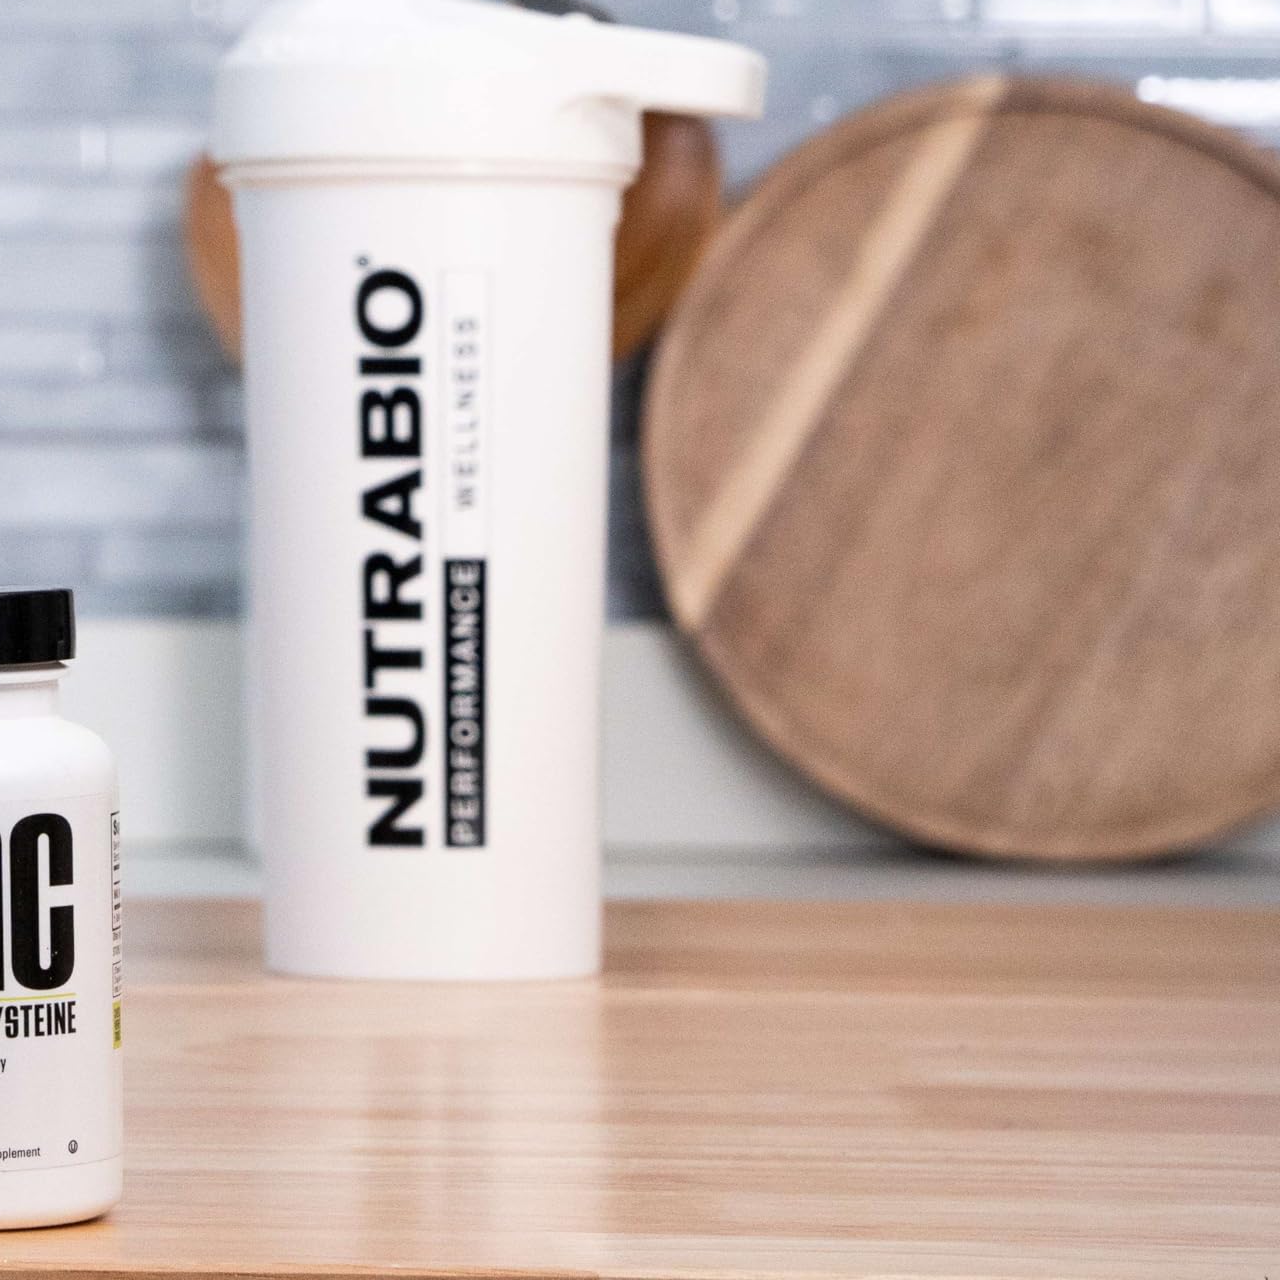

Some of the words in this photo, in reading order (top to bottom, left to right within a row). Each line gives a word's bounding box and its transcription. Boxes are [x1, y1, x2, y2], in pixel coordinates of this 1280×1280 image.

[452, 317, 478, 510] WELLNESS
[354, 268, 427, 849] NUTRABIO
[449, 562, 480, 845] PERFORMANCE
